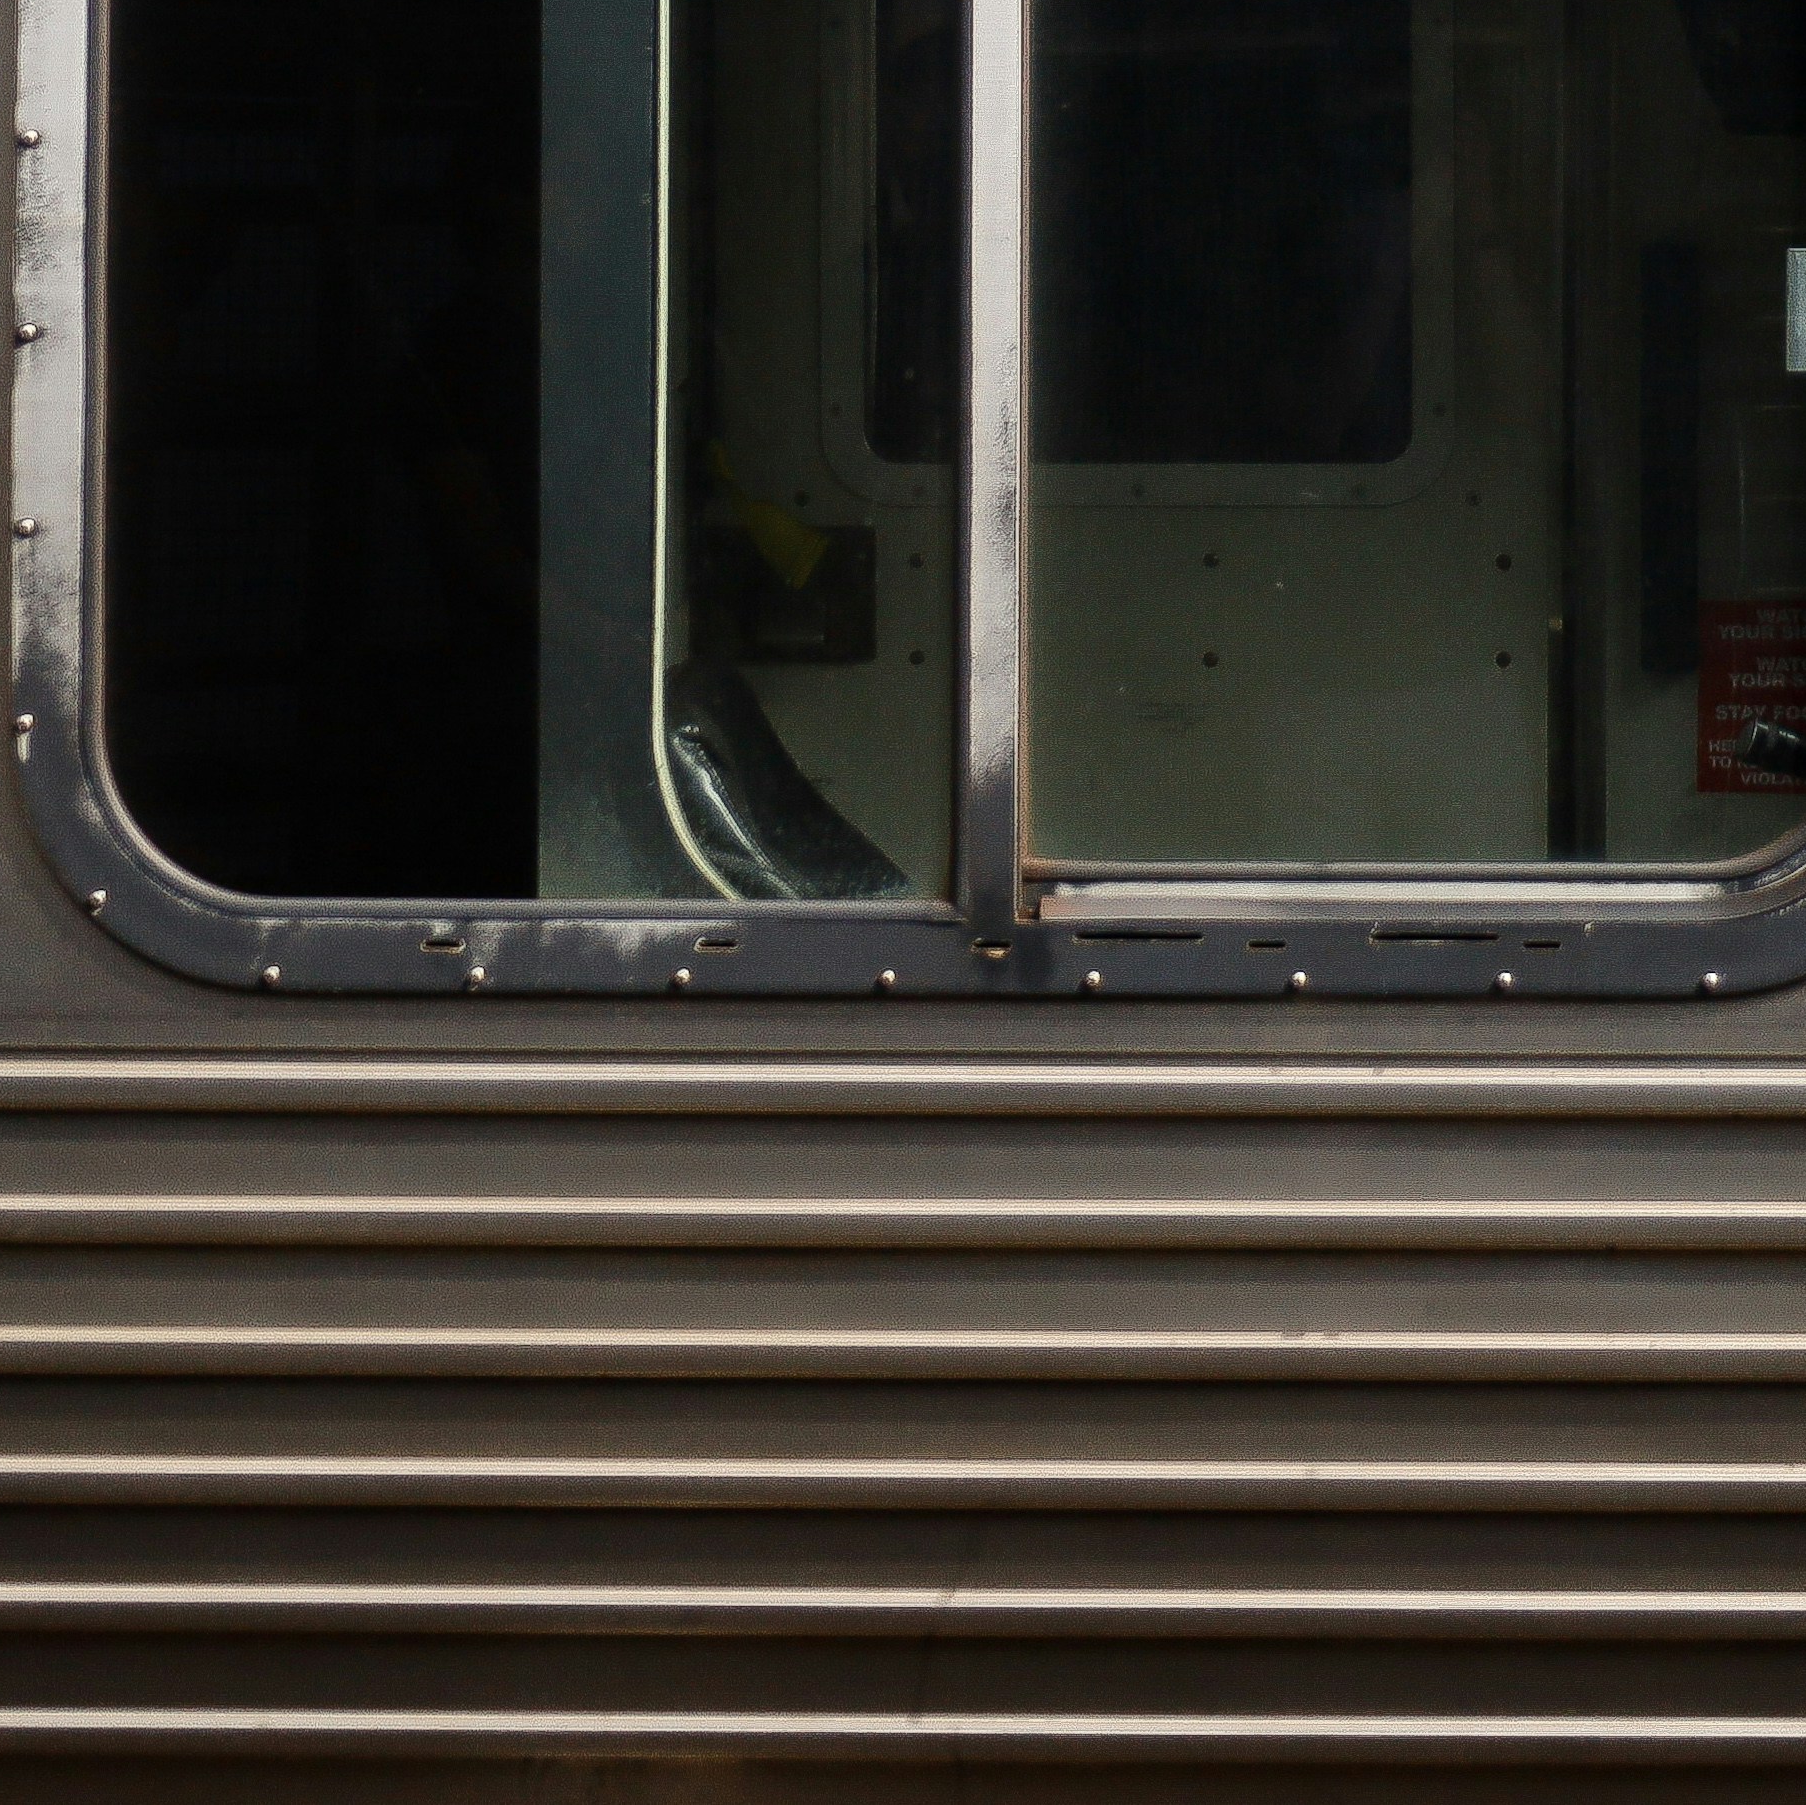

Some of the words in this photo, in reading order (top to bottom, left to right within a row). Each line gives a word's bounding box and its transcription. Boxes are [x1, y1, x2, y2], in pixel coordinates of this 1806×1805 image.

[1718, 624, 1775, 640] YOUR
[1729, 673, 1786, 689] YOUR
[1715, 704, 1767, 721] STAY
